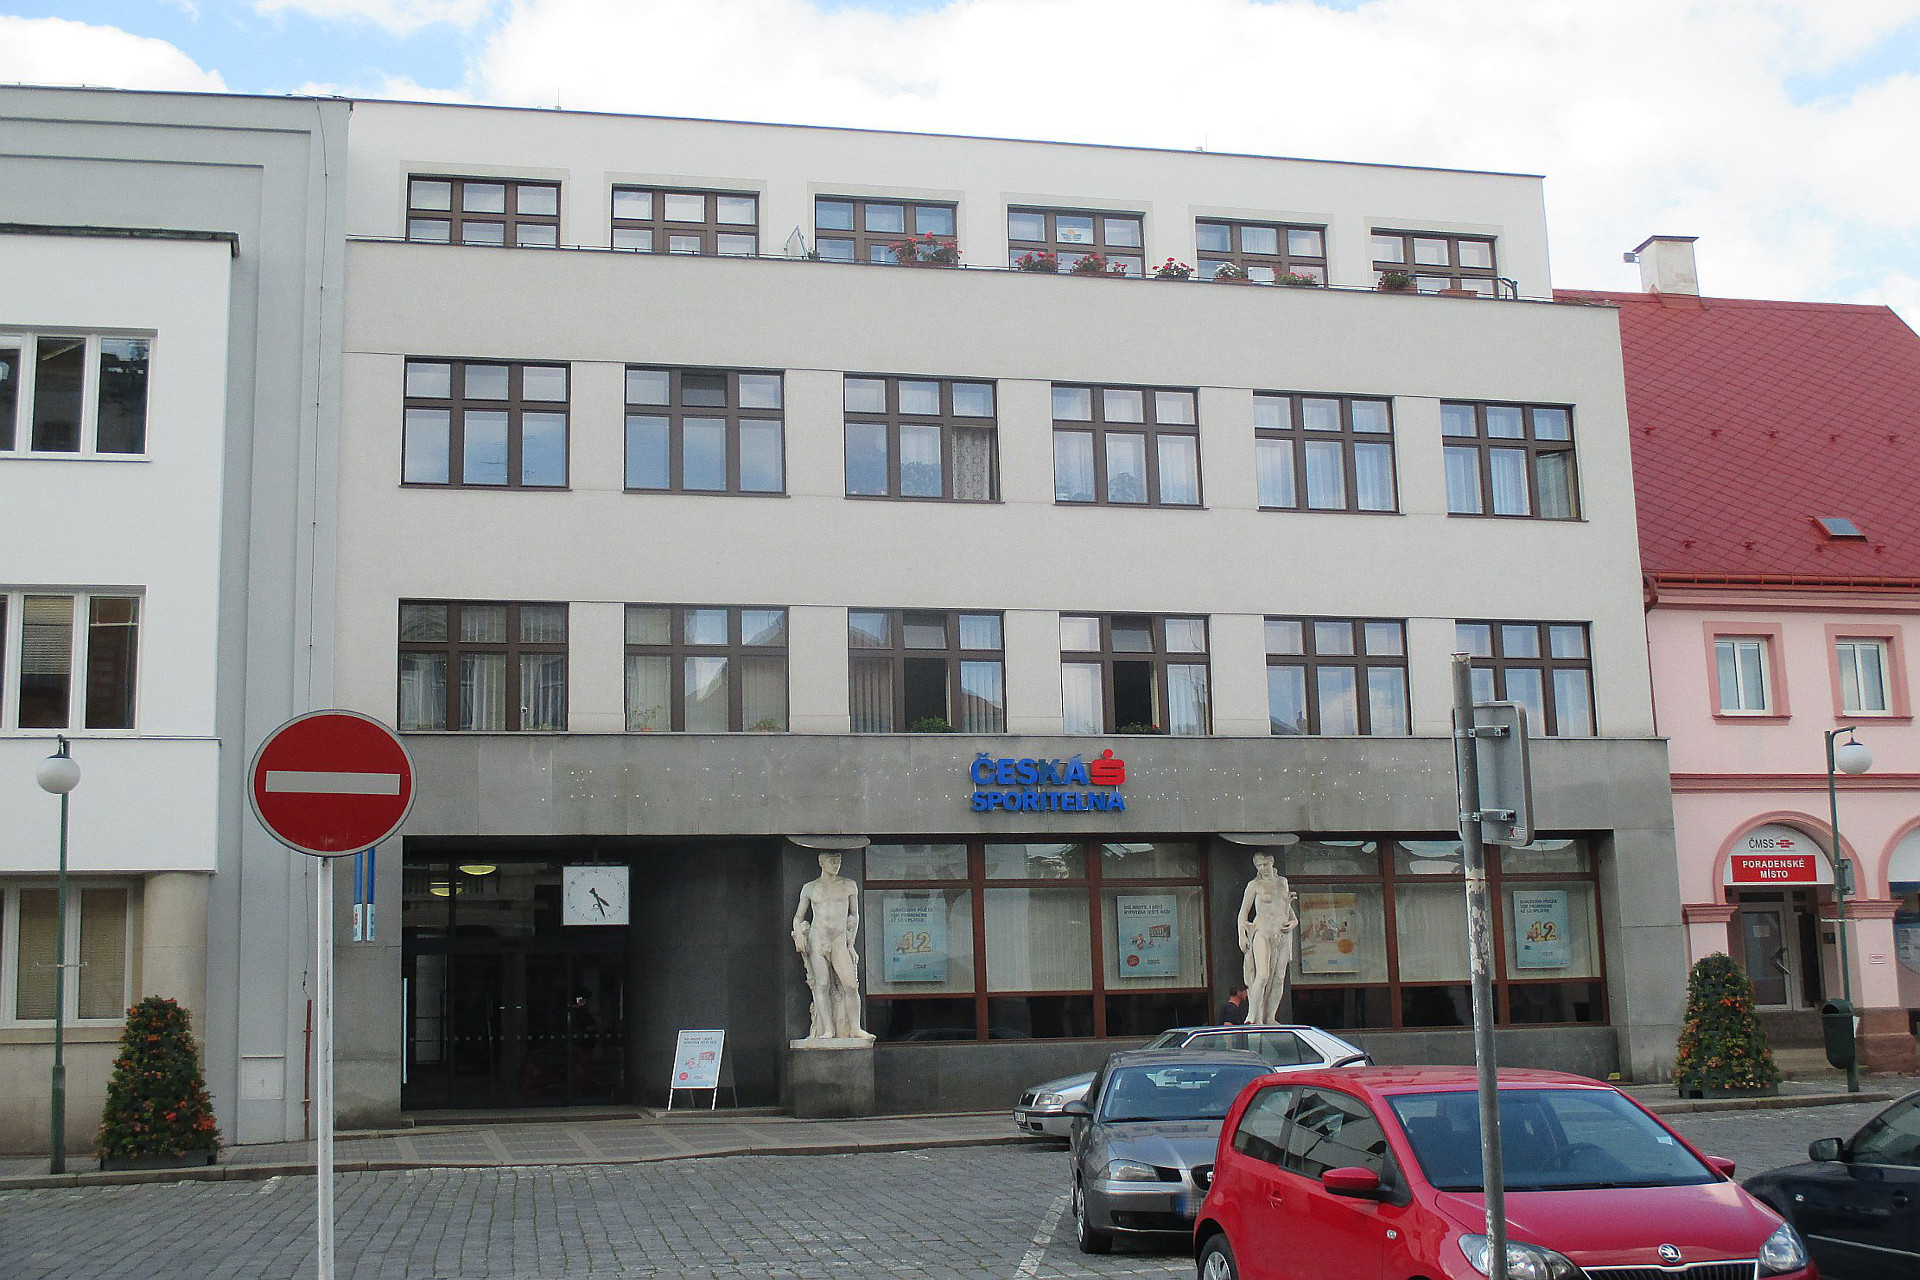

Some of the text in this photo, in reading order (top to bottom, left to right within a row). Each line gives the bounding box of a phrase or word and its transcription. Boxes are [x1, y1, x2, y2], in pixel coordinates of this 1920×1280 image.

[970, 752, 1089, 785] ČESKÁ
[971, 787, 1127, 811] SPOŘITELNA
[1748, 837, 1774, 849] ČMSS
[1742, 858, 1805, 868] PORADENSKÉ
[1760, 869, 1789, 879] MÍSTO
[1532, 920, 1557, 942] 12
[902, 931, 932, 954] 12
